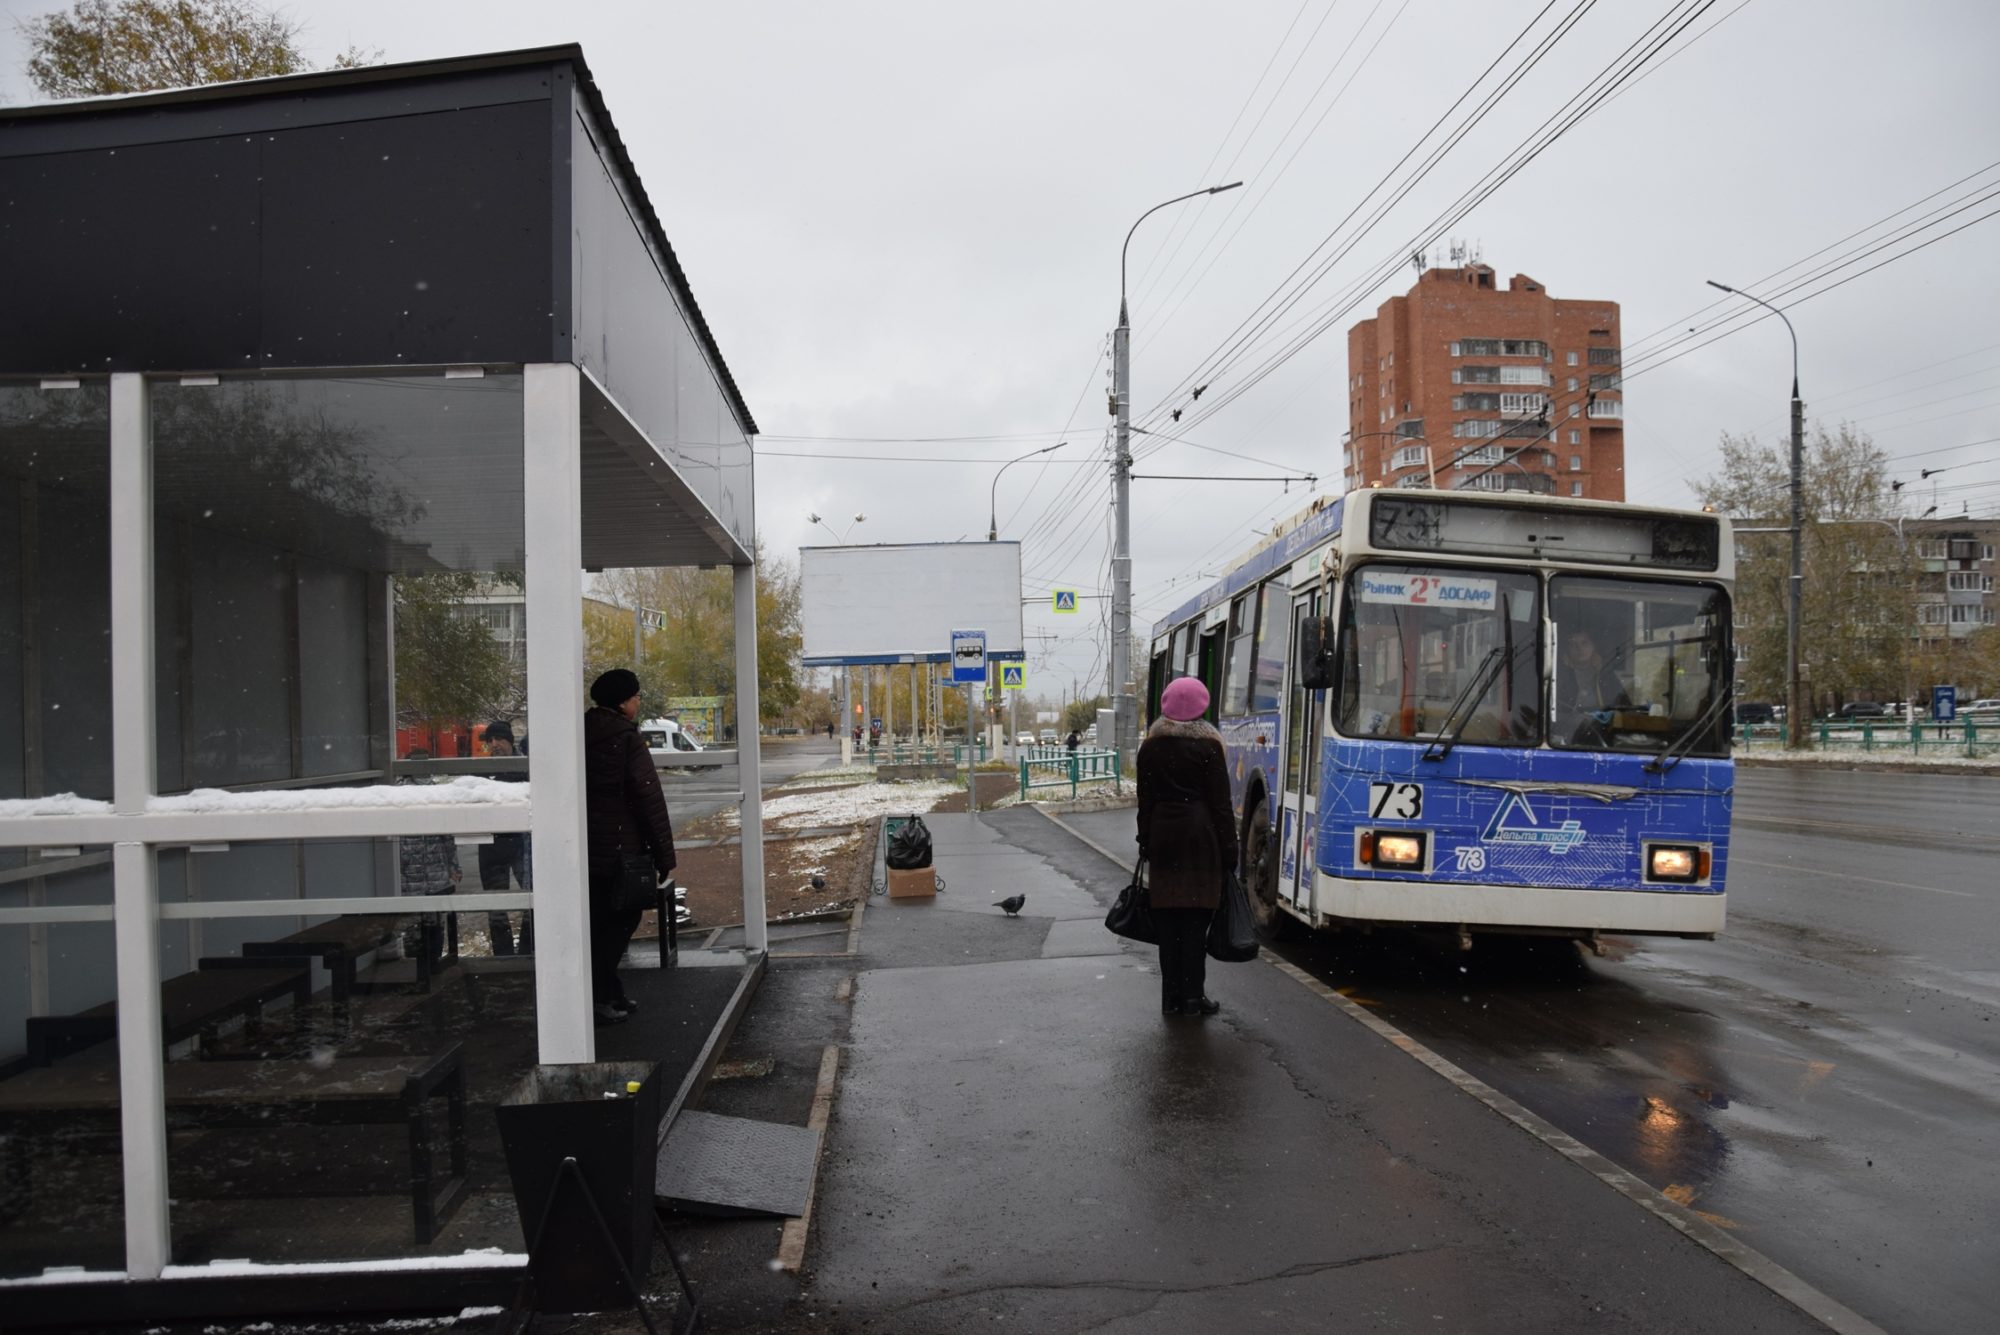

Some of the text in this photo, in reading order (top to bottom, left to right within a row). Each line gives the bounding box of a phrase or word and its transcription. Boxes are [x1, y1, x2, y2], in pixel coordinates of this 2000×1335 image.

[1371, 782, 1422, 819] 73
[1541, 831, 1569, 842] плюс
[1456, 847, 1484, 870] 73
